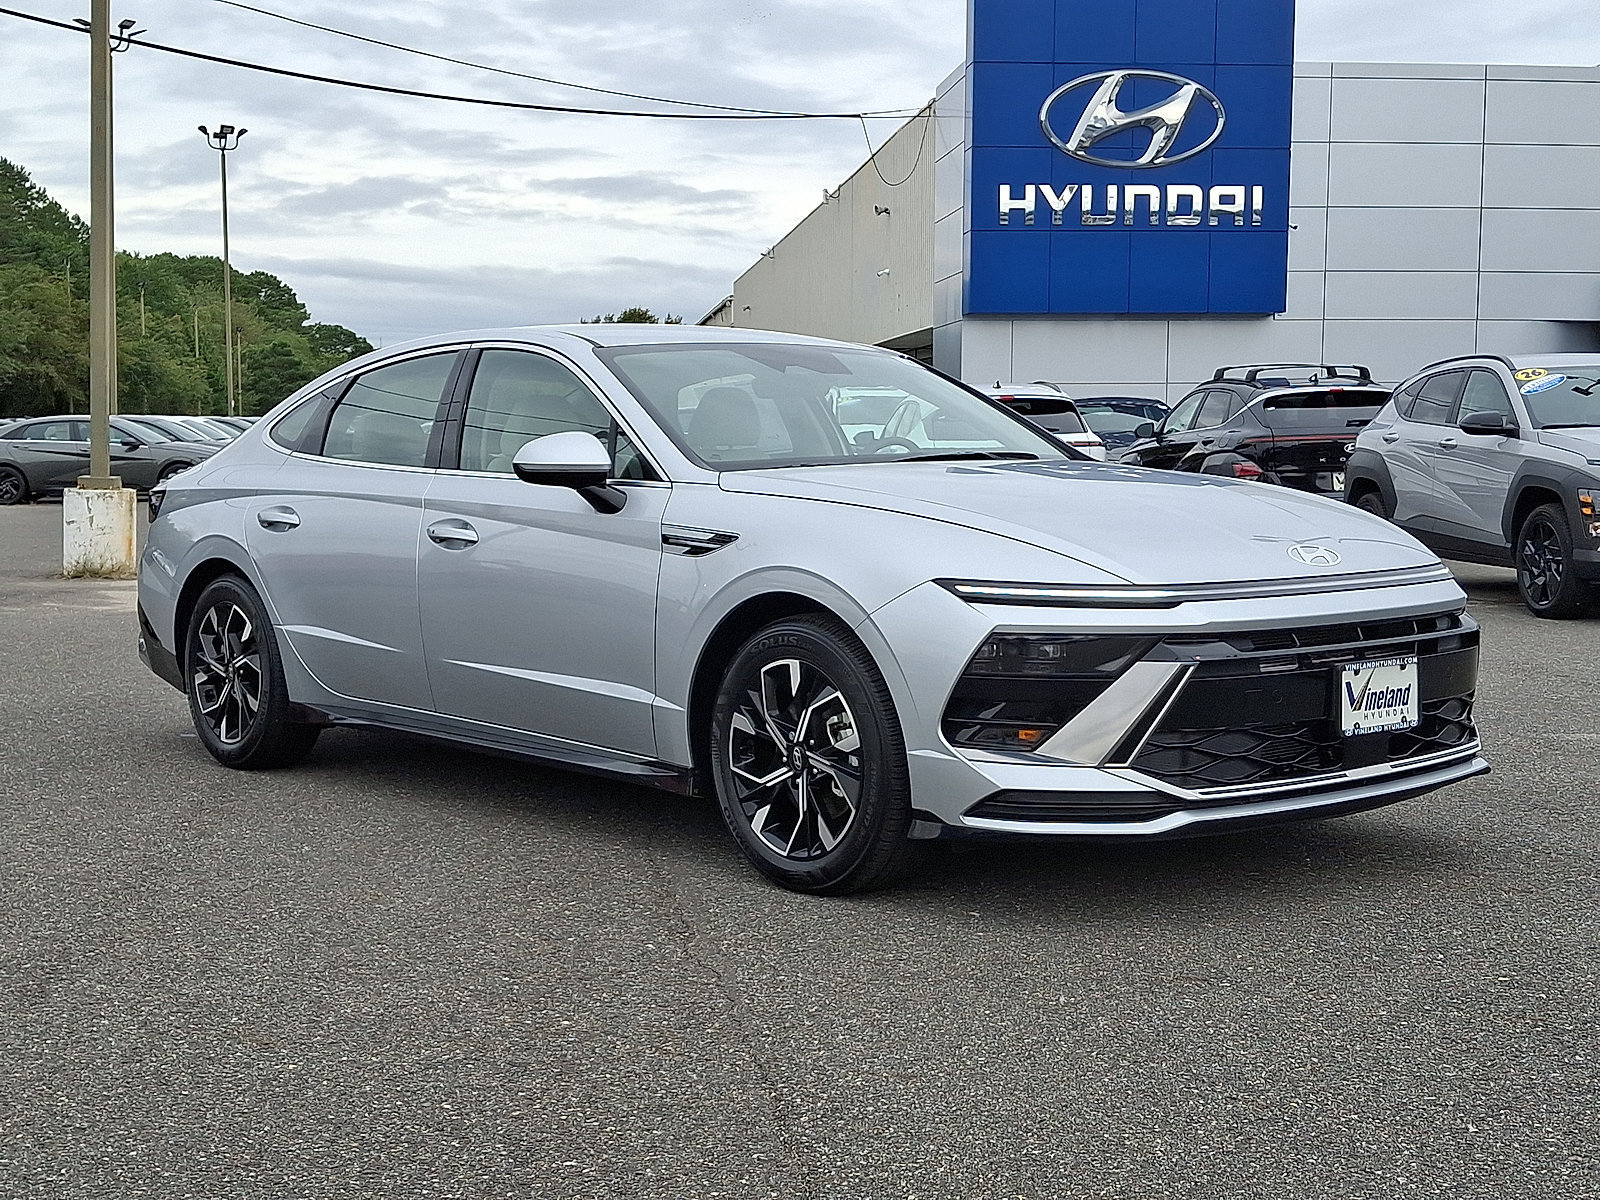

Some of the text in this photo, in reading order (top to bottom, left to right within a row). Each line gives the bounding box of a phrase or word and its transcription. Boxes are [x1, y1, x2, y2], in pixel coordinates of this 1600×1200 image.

[998, 184, 1264, 226] HYUNDAI
[1520, 370, 1543, 379] 26
[1345, 668, 1411, 712] Vineland
[1364, 707, 1409, 720] HYUNDAI
